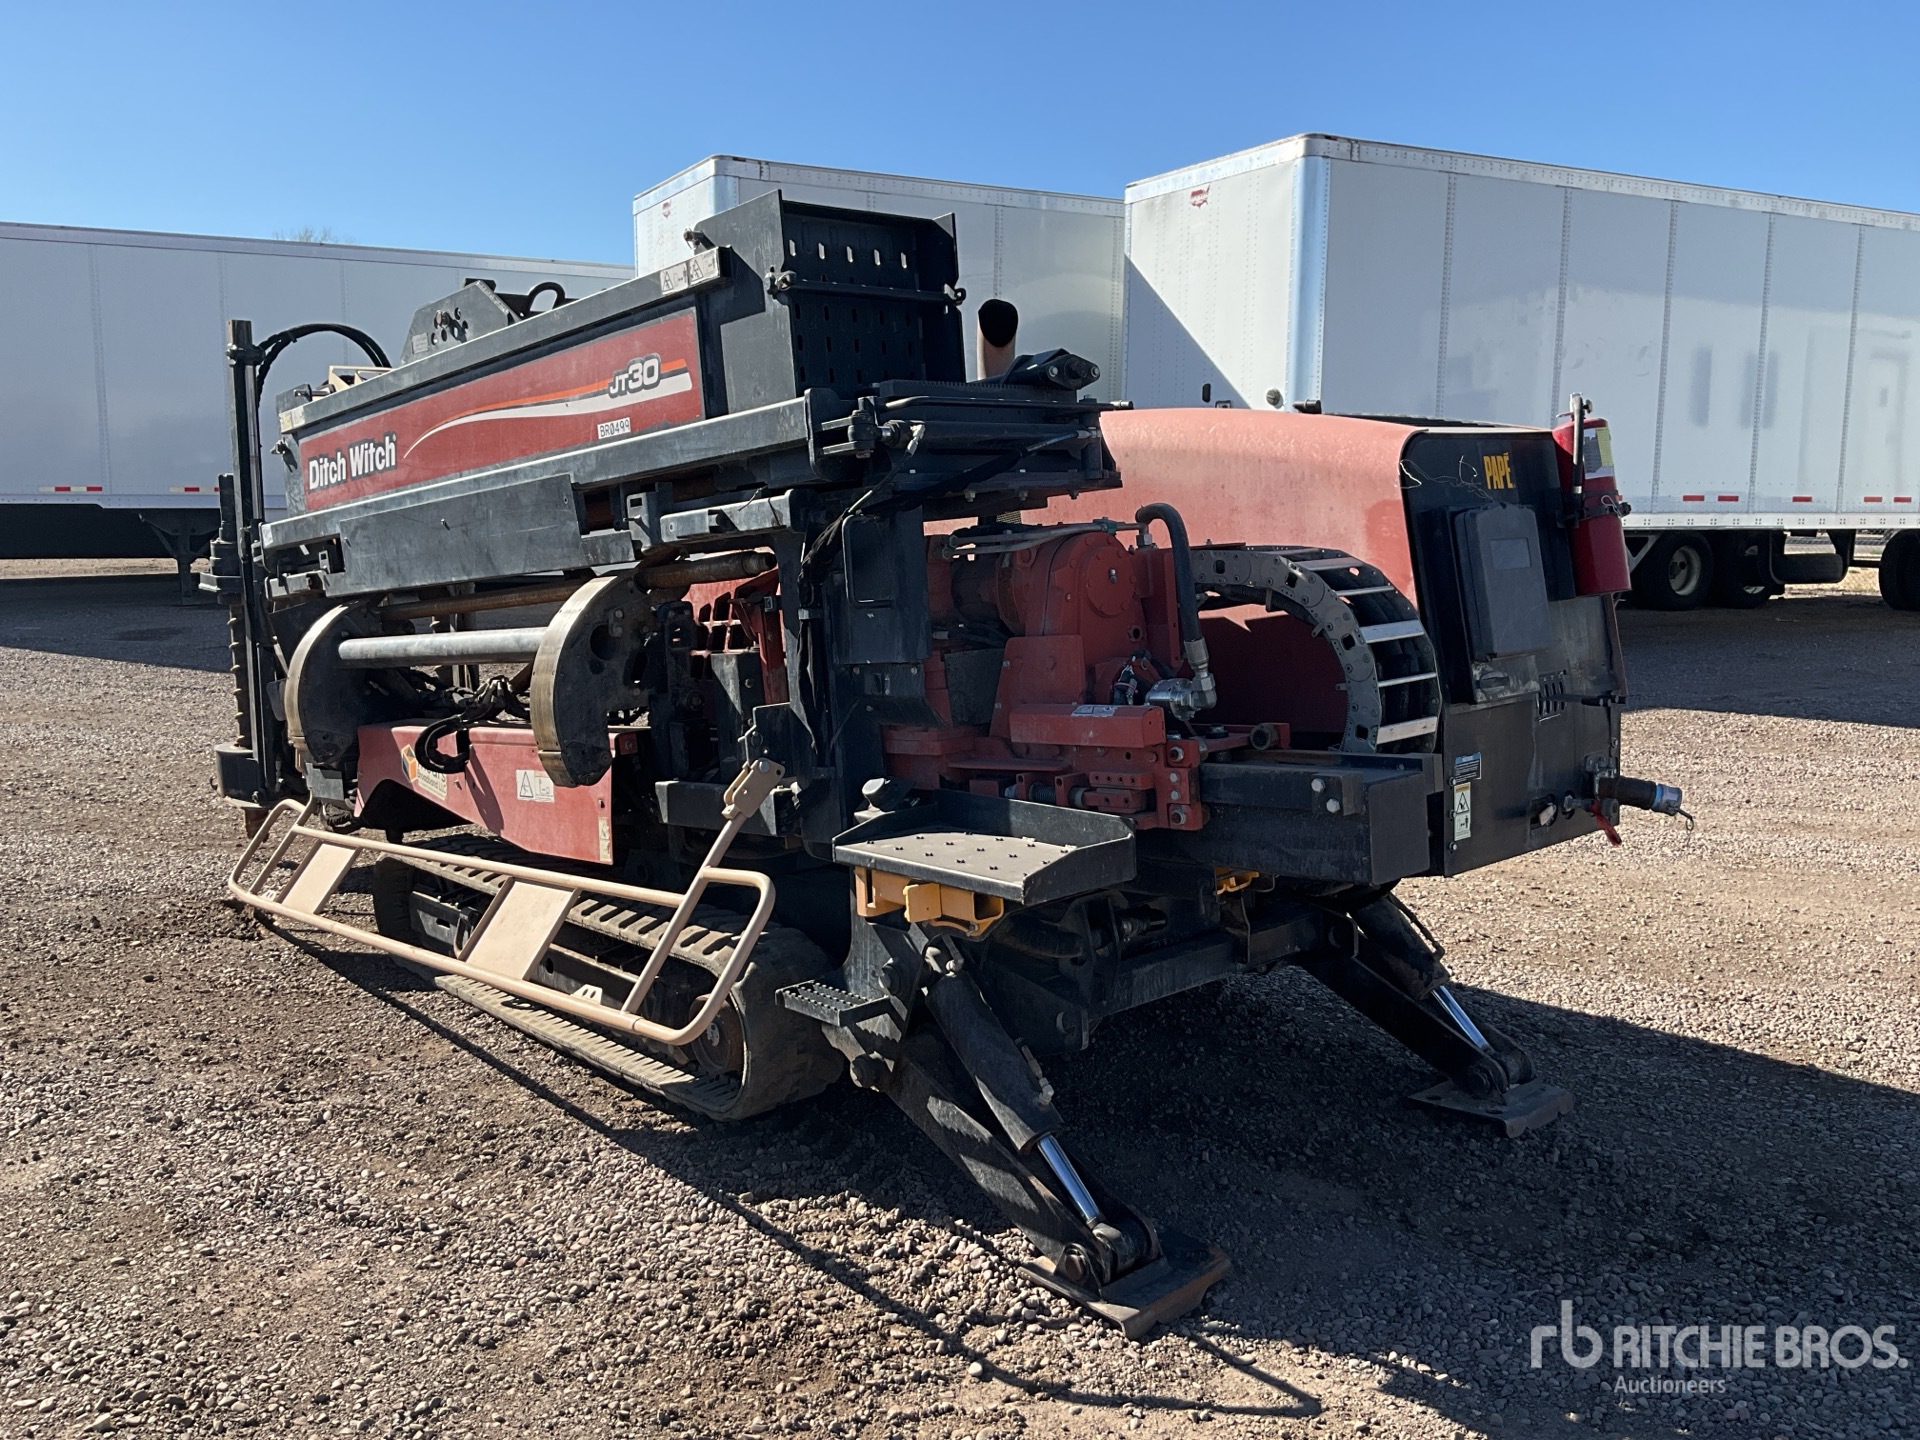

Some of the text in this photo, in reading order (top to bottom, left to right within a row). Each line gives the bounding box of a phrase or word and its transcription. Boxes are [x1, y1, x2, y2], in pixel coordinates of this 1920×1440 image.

[609, 357, 660, 395] JT30
[309, 435, 396, 490] Ditch Witch
